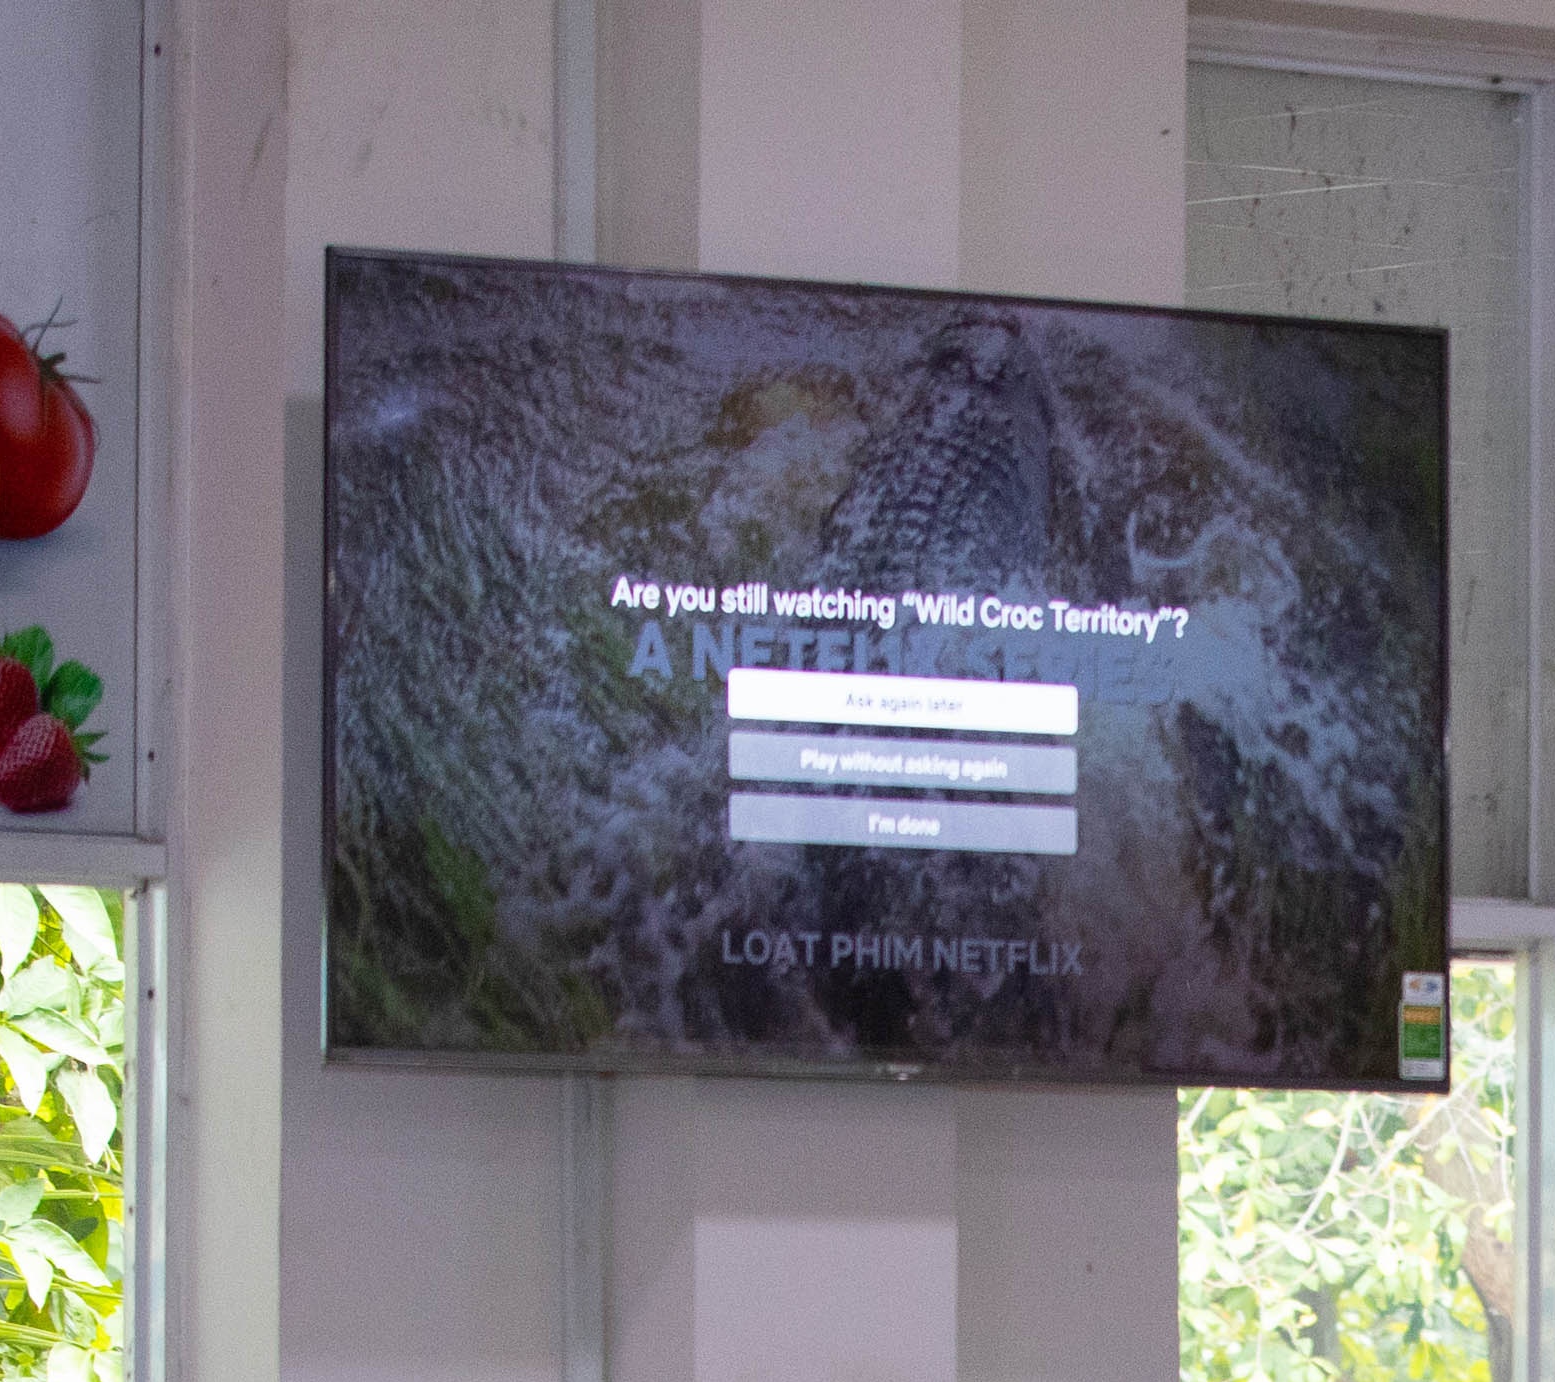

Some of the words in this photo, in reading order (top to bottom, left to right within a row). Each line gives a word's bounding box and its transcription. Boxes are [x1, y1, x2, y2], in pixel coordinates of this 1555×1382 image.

[611, 576, 660, 609] Are
[665, 584, 716, 618] you
[721, 582, 768, 615] still
[773, 588, 896, 630] watching
[980, 596, 1044, 631] Croc
[800, 748, 838, 776] Play
[839, 750, 904, 774] without
[905, 754, 960, 781] asking
[961, 758, 1008, 783] again
[897, 814, 940, 836] done
[830, 931, 923, 971] PHIM
[932, 936, 1084, 977] NETFLIX
